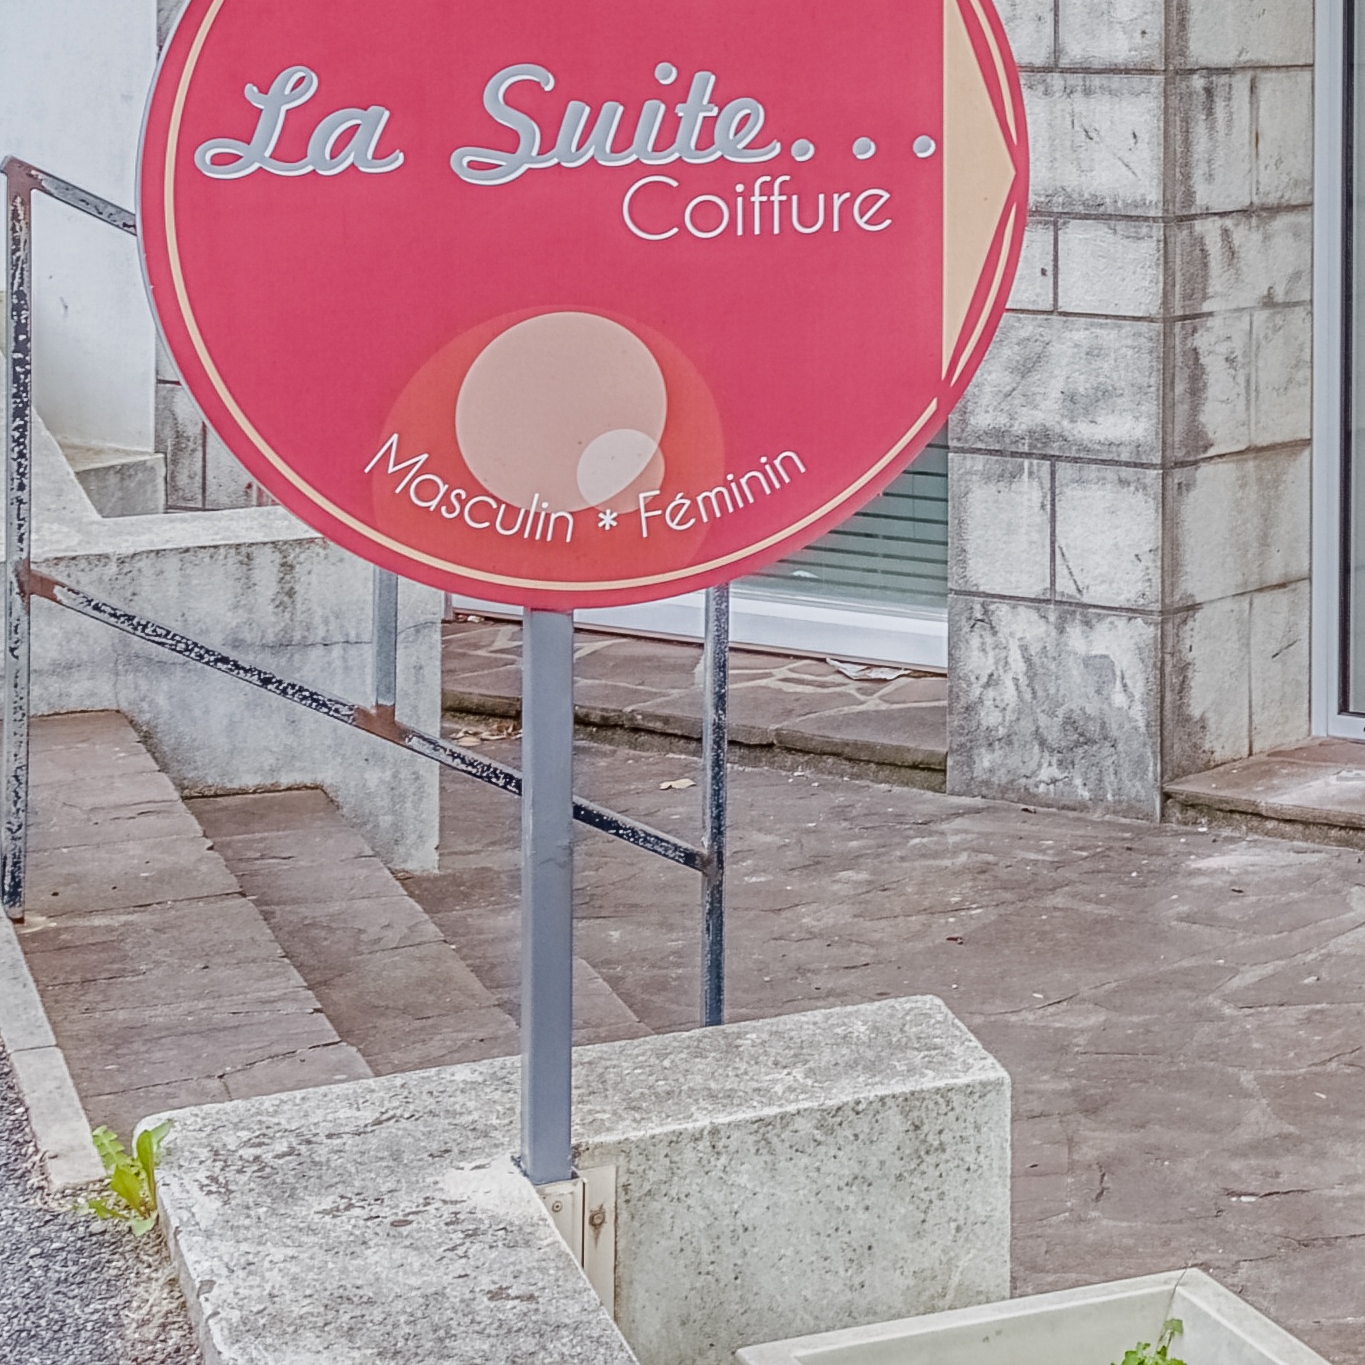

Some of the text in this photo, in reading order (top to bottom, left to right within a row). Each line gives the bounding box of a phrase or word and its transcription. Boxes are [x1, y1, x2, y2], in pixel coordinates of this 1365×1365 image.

[194, 65, 405, 180] La
[622, 175, 892, 241] Coiffure
[363, 432, 807, 543] Masculin Féminin
